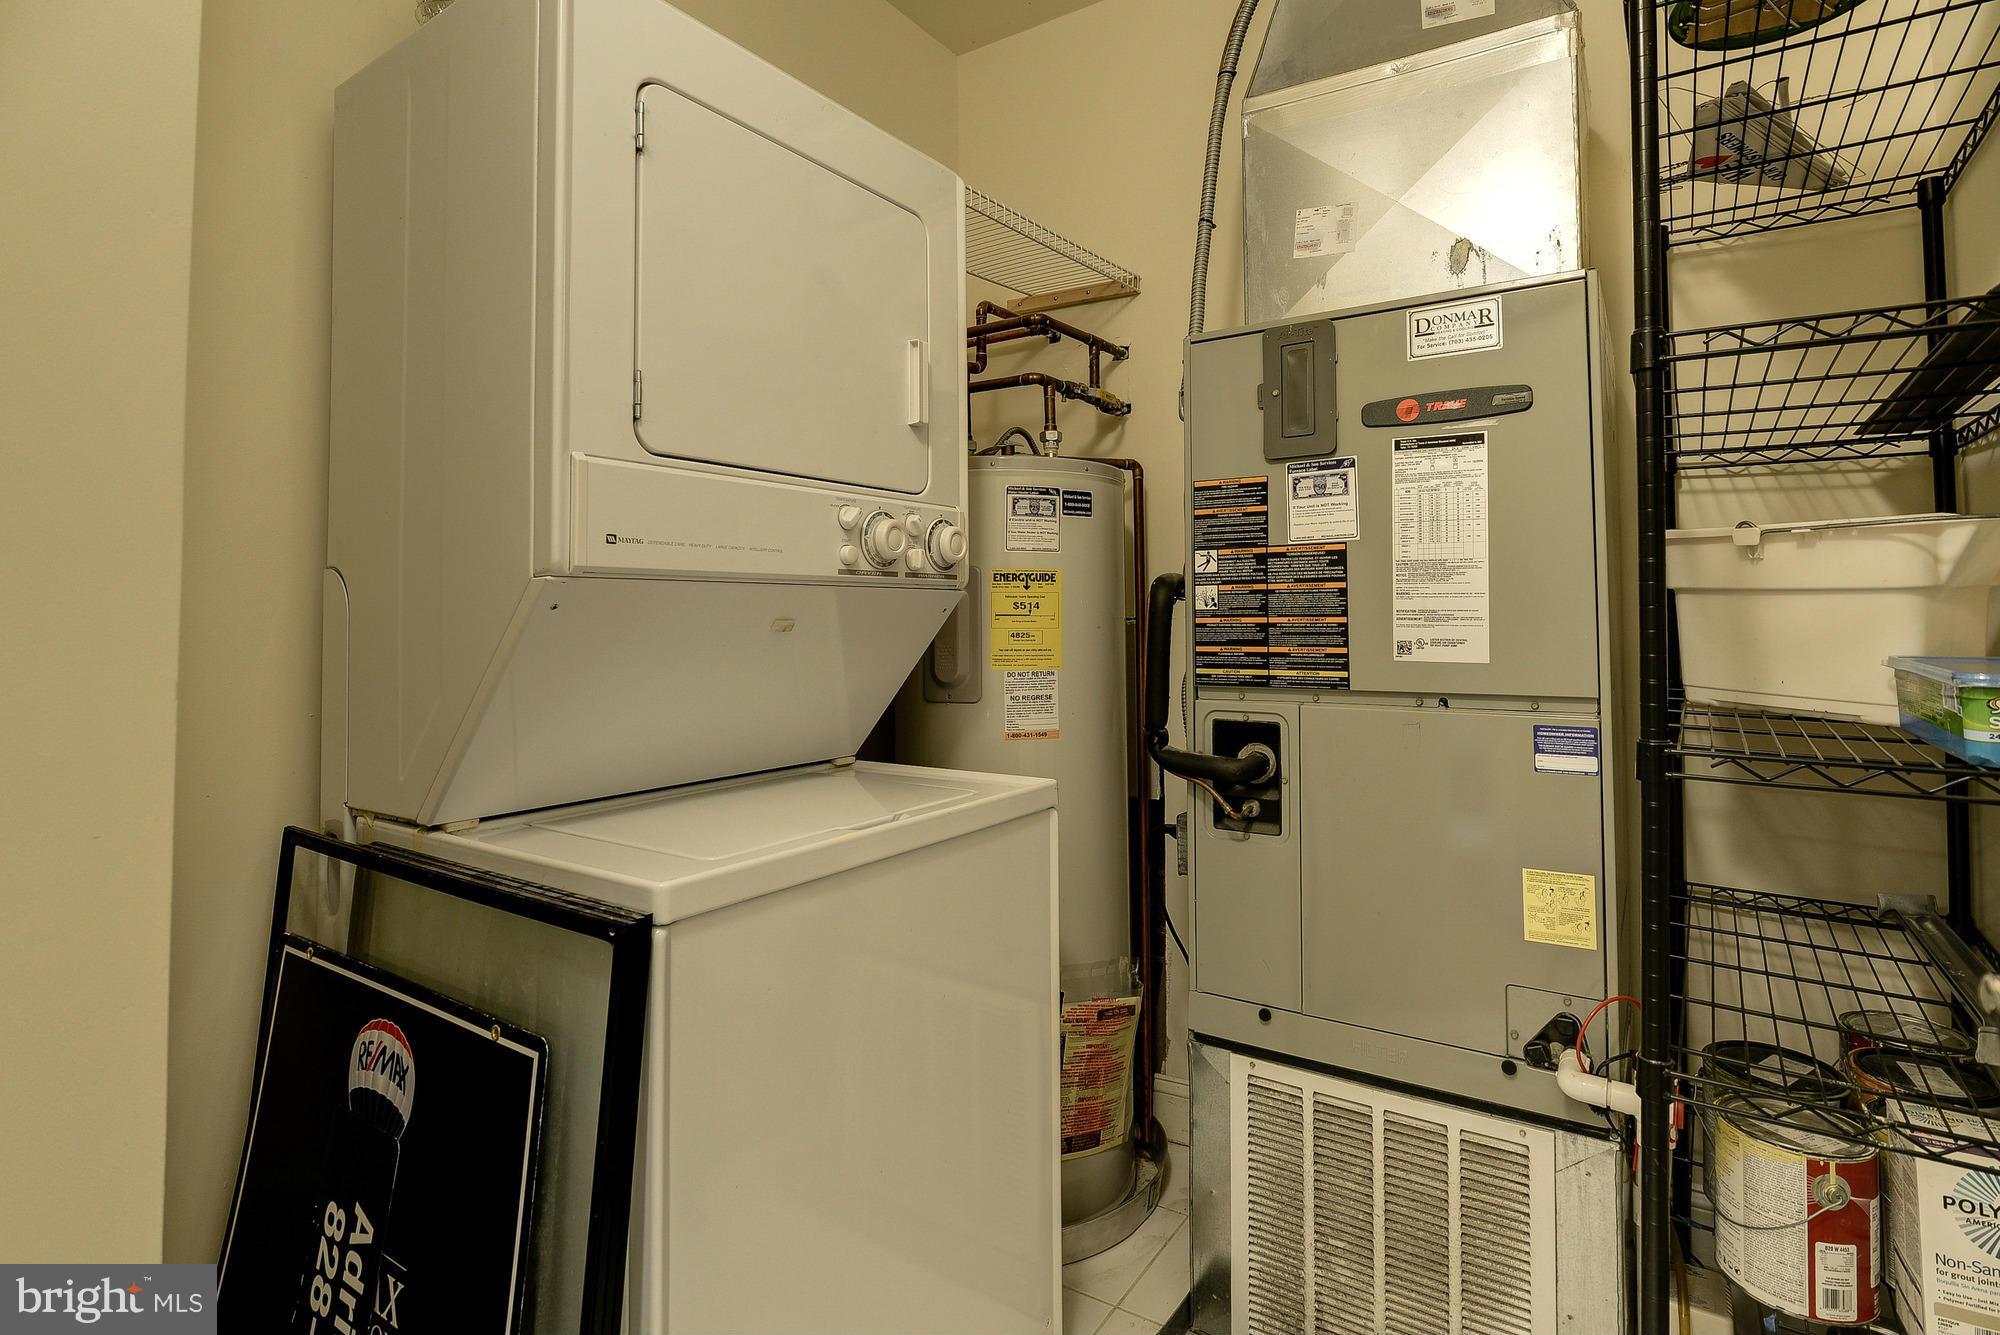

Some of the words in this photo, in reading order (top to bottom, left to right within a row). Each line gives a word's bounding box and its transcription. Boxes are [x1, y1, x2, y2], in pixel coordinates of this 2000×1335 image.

[1414, 308, 1494, 334] DONMAR
[1431, 319, 1478, 332] COMPANY
[1465, 333, 1493, 342] 435-0205
[993, 572, 1057, 583] ENERGYGUIDE
[1012, 601, 1040, 611] $514
[357, 1040, 410, 1096] RE/MAX
[1935, 1267, 1949, 1276] for
[1950, 1272, 1976, 1283] grout
[1942, 1289, 1955, 1297] Easy
[1962, 1293, 1973, 1301] Use
[1942, 1296, 1965, 1305] Polymer
[1965, 1302, 1988, 1311] Fortified
